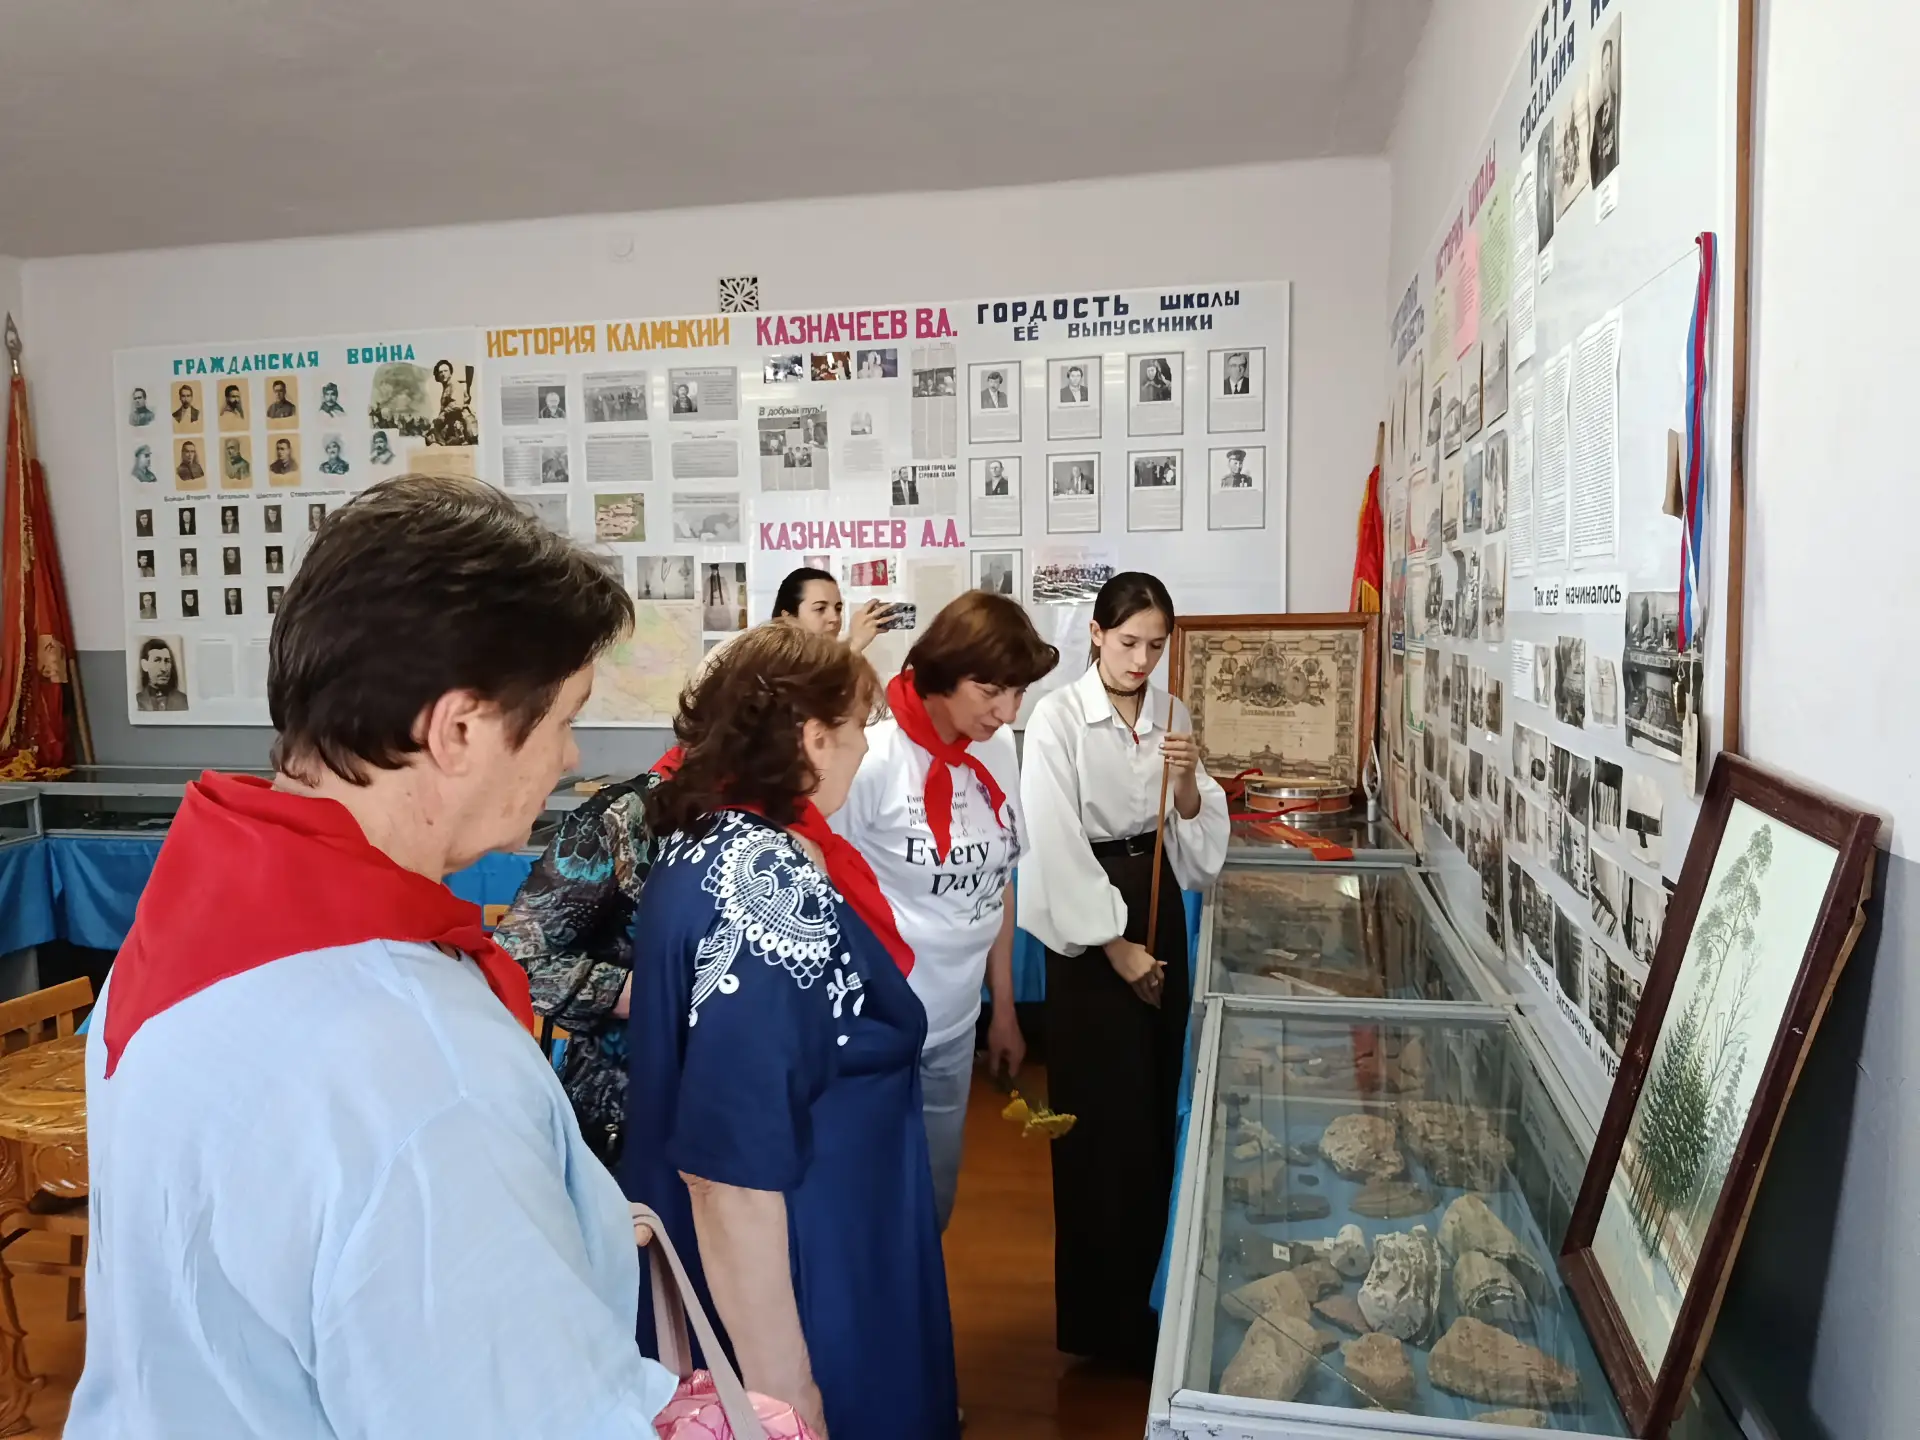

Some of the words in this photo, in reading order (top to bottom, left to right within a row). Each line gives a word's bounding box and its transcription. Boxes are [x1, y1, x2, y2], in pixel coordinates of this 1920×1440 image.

[1520, 20, 1575, 154] СОЗДАНИЯ
[977, 294, 1130, 325] ГОРДОСТЬ
[1160, 290, 1240, 311] ШКОЛЫ
[486, 324, 596, 358] ИСТОРИЯ
[606, 317, 730, 352] КАЛМЫКИИ
[756, 309, 908, 346] КАЗНАЧЕЕВ
[1013, 322, 1039, 342] ЕЁ
[1067, 314, 1213, 339] ВЫПУСКНИКИ
[173, 350, 319, 376] ГРАЖДАНСКАЯ
[346, 342, 415, 365] ВОЙНА
[760, 520, 907, 550] КАЗНАЧЕЕВ
[921, 518, 966, 548] А.А.
[1533, 586, 1545, 606] Так
[1565, 584, 1622, 605] начиналось
[931, 872, 986, 897] Day
[1556, 989, 1592, 1049] экспонаты
